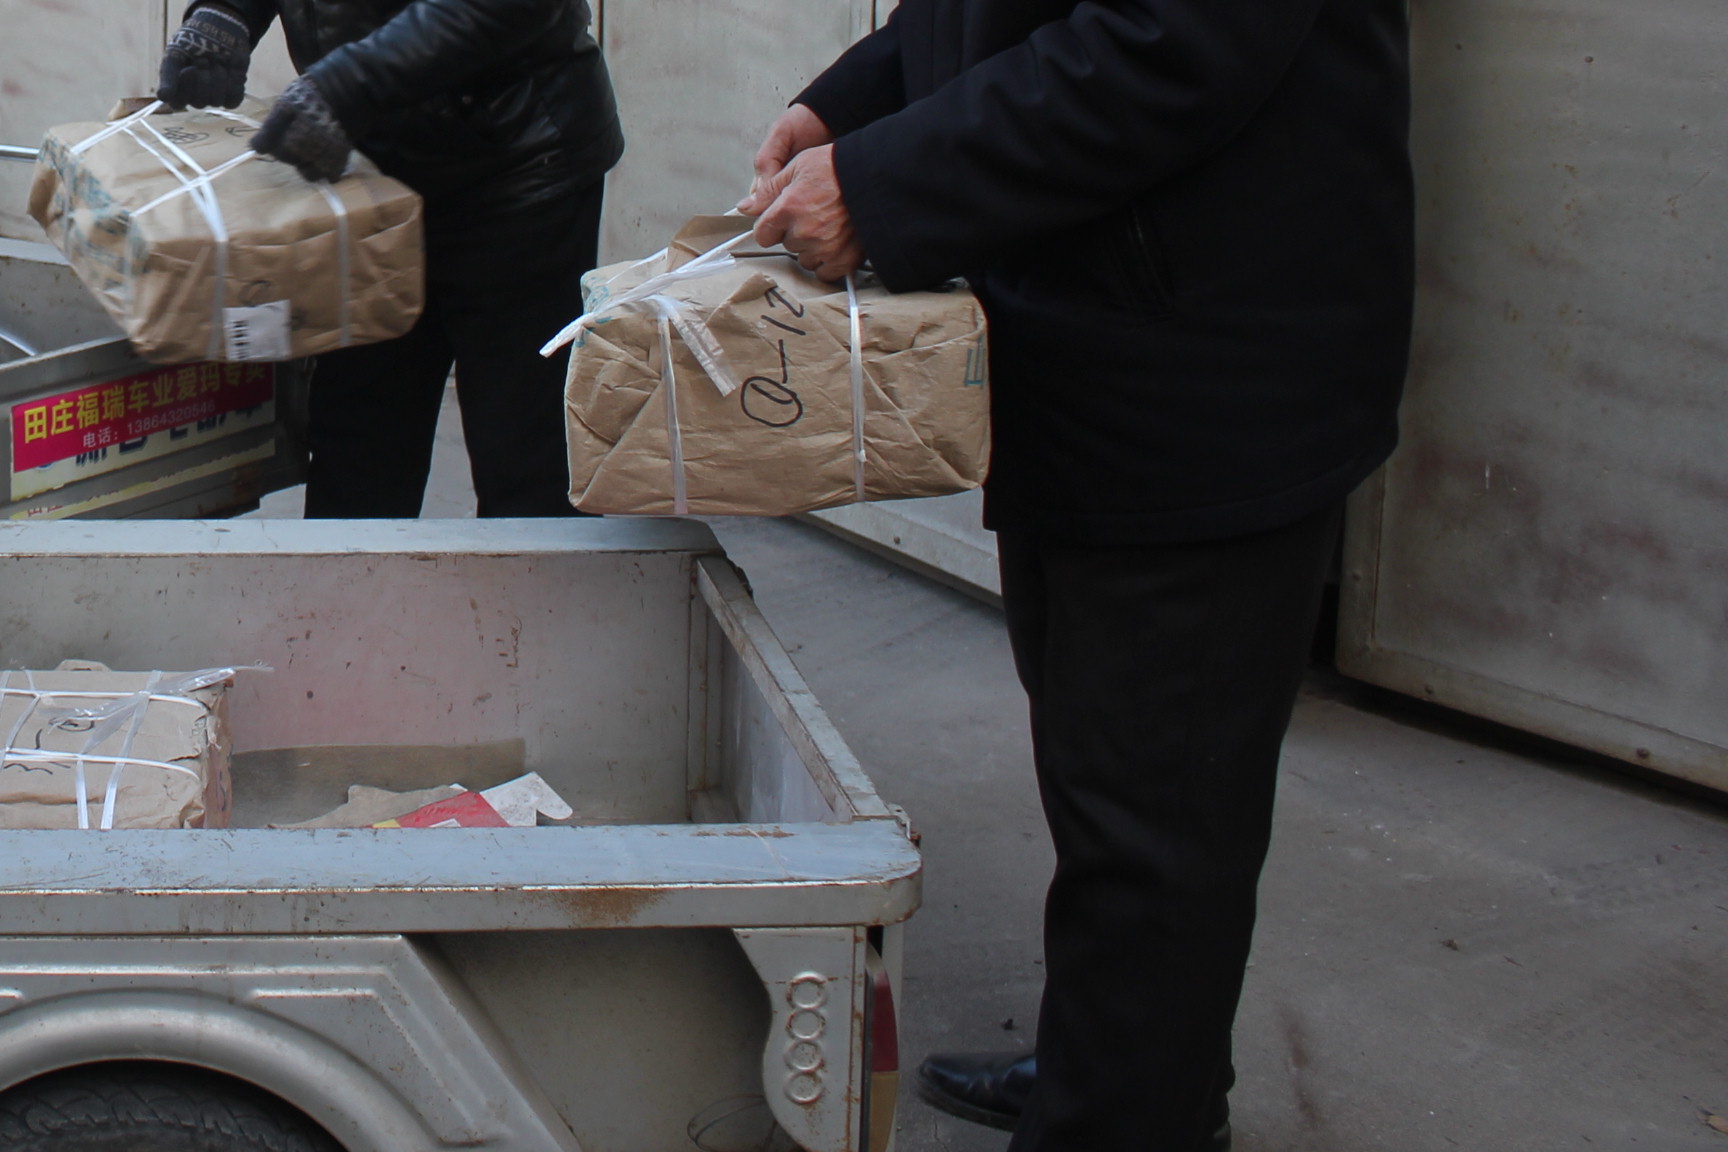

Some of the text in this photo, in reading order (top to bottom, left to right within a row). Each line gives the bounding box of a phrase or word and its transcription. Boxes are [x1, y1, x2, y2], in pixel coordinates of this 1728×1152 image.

[23, 362, 267, 444] 田庄福瑞车业爱玛专卖
